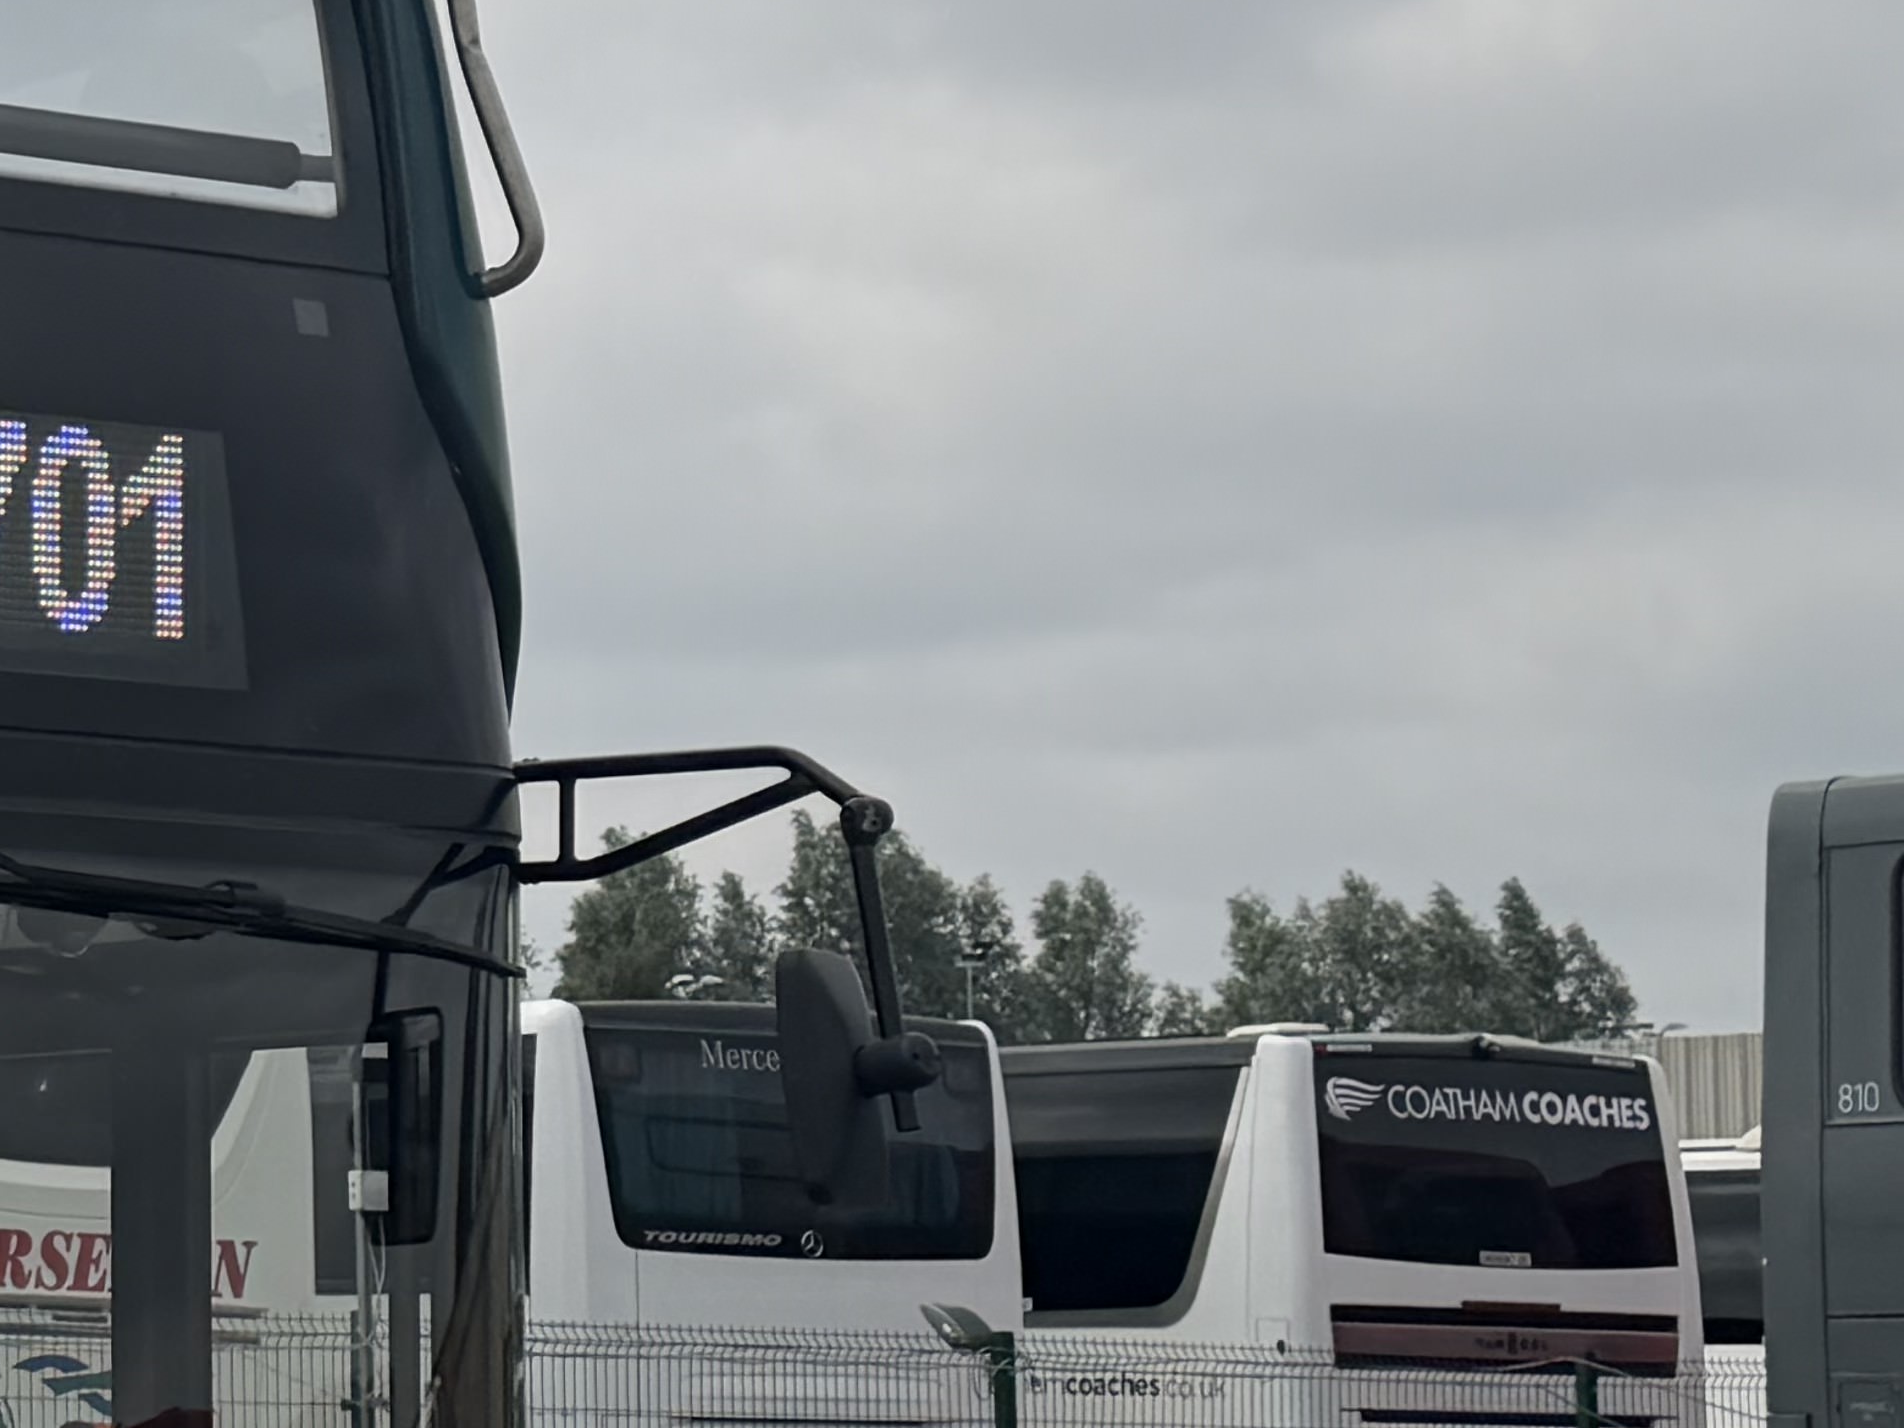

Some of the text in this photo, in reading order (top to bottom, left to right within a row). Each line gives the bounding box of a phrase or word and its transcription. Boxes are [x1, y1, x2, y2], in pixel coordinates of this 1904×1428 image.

[1386, 1084, 1651, 1131] COATHAM COACHES
[1837, 1081, 1880, 1113] 810
[643, 1230, 783, 1248] TOURISMO
